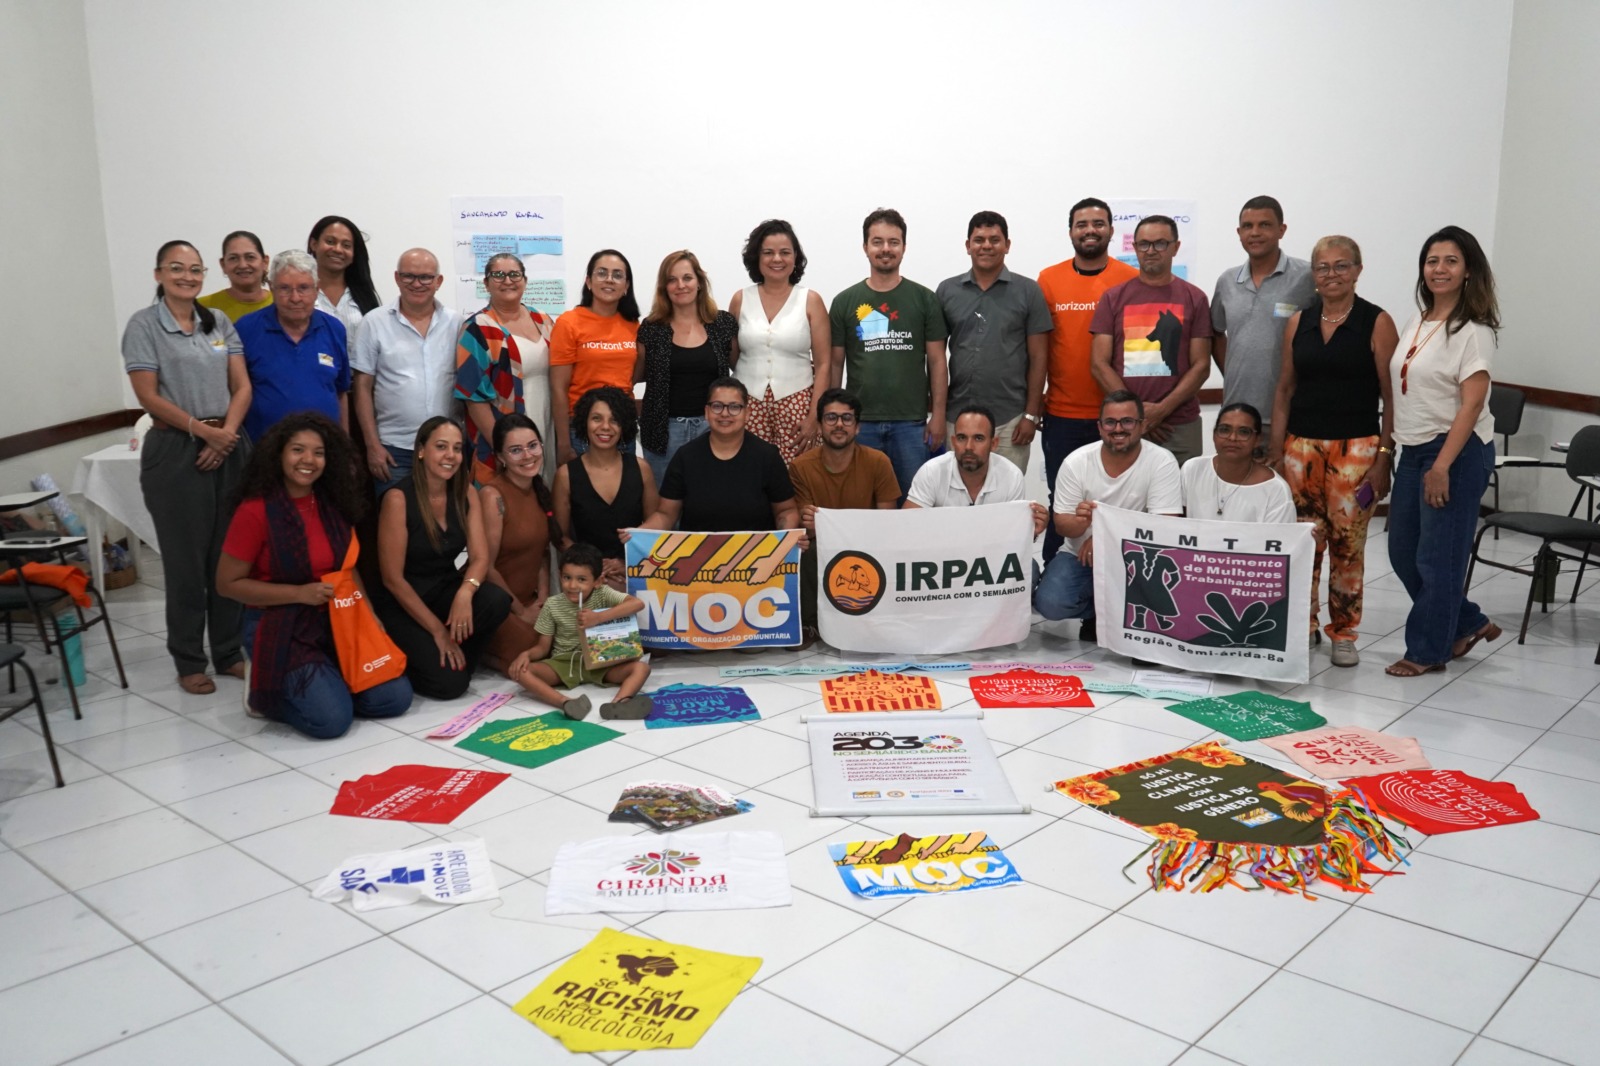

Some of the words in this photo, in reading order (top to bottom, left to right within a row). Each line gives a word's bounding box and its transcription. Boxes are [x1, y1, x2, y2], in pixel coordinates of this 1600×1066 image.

[1056, 301, 1096, 312] horizont
[864, 344, 884, 352] MUDAR
[1193, 554, 1282, 568] Movimento
[896, 552, 1025, 592] IRPAA
[1183, 564, 1204, 574] de
[1206, 566, 1282, 579] Mulheres
[1184, 574, 1282, 588] Trabalhadoras
[954, 591, 972, 599] COM
[983, 586, 1025, 597] SEMIÁRIDO
[1231, 588, 1282, 598] Rurais
[636, 586, 790, 634] MOC
[692, 634, 741, 644] ORGANIZAÇÃO
[743, 632, 790, 641] COMUNITÁRIA
[1123, 632, 1173, 648] Região
[1178, 643, 1284, 663] Semi-árida-Ba
[1148, 776, 1224, 799] CLIMÁTICA
[1188, 787, 1213, 798] COM
[1229, 786, 1253, 796] DE
[1203, 796, 1260, 817] GÊNERO
[851, 856, 1009, 890] MOC
[608, 884, 728, 898] MULHERES
[553, 981, 700, 1021] RACISMO
[558, 1000, 602, 1016] NÃO
[620, 1012, 666, 1028] TEM
[528, 1005, 675, 1045] AGROECOLOGIA
